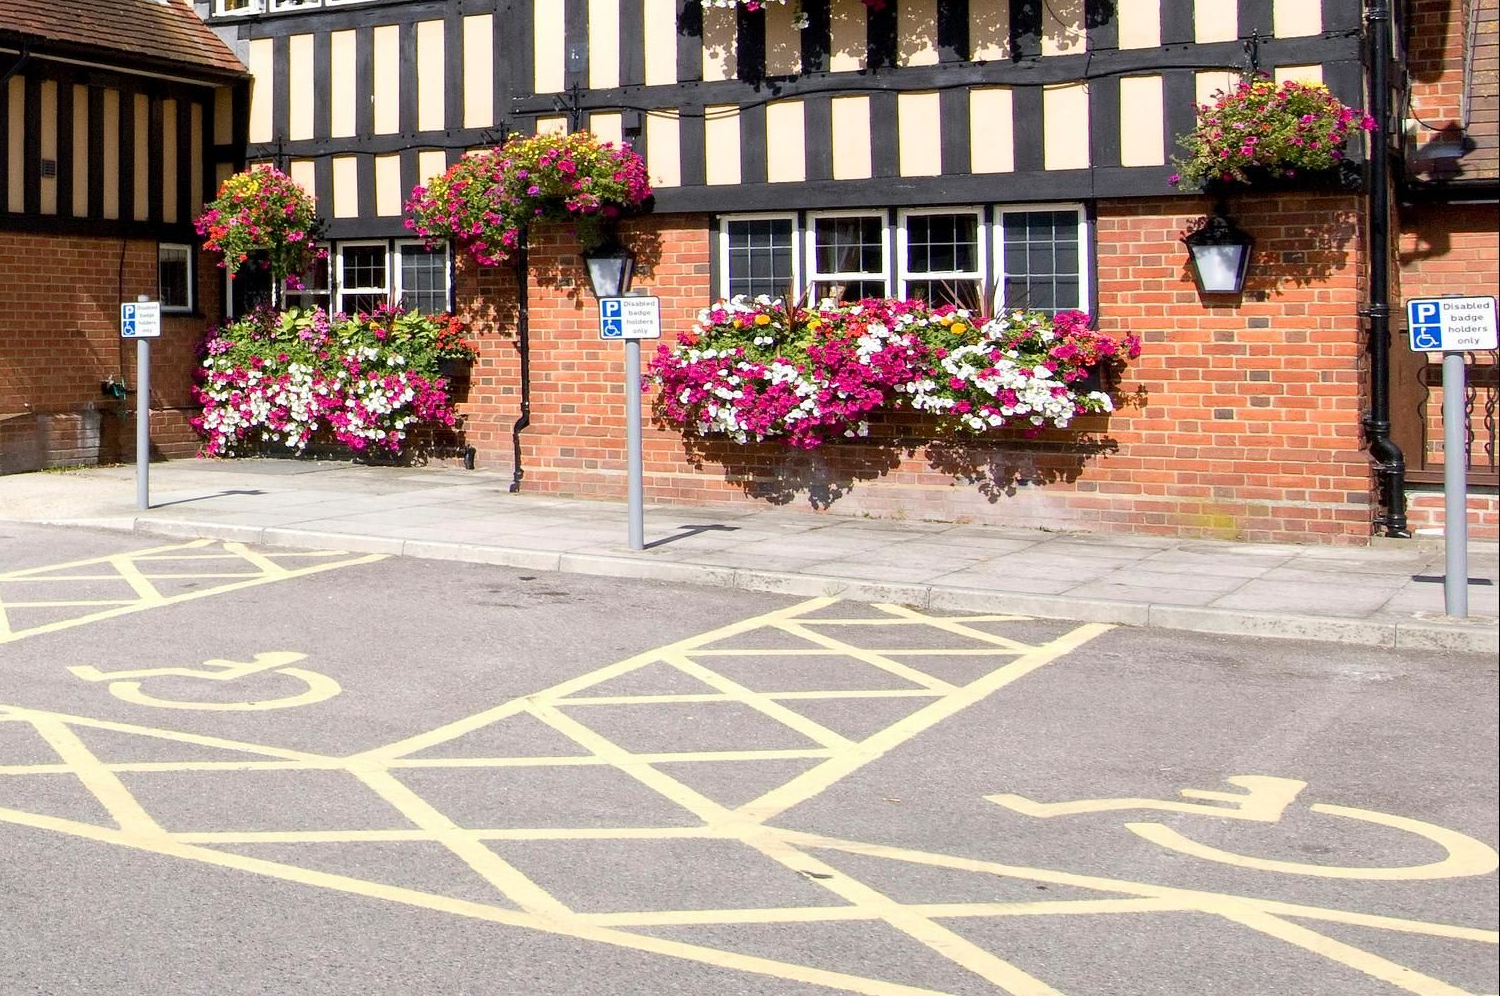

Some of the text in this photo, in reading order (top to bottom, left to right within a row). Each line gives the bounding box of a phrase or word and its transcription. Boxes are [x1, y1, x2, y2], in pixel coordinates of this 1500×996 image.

[605, 301, 619, 317] P
[1443, 302, 1490, 311] Disabled
[125, 305, 135, 319] P
[1418, 304, 1436, 323] P
[1450, 314, 1484, 322] badge
[1448, 325, 1488, 333] holders
[1457, 336, 1480, 345] only
